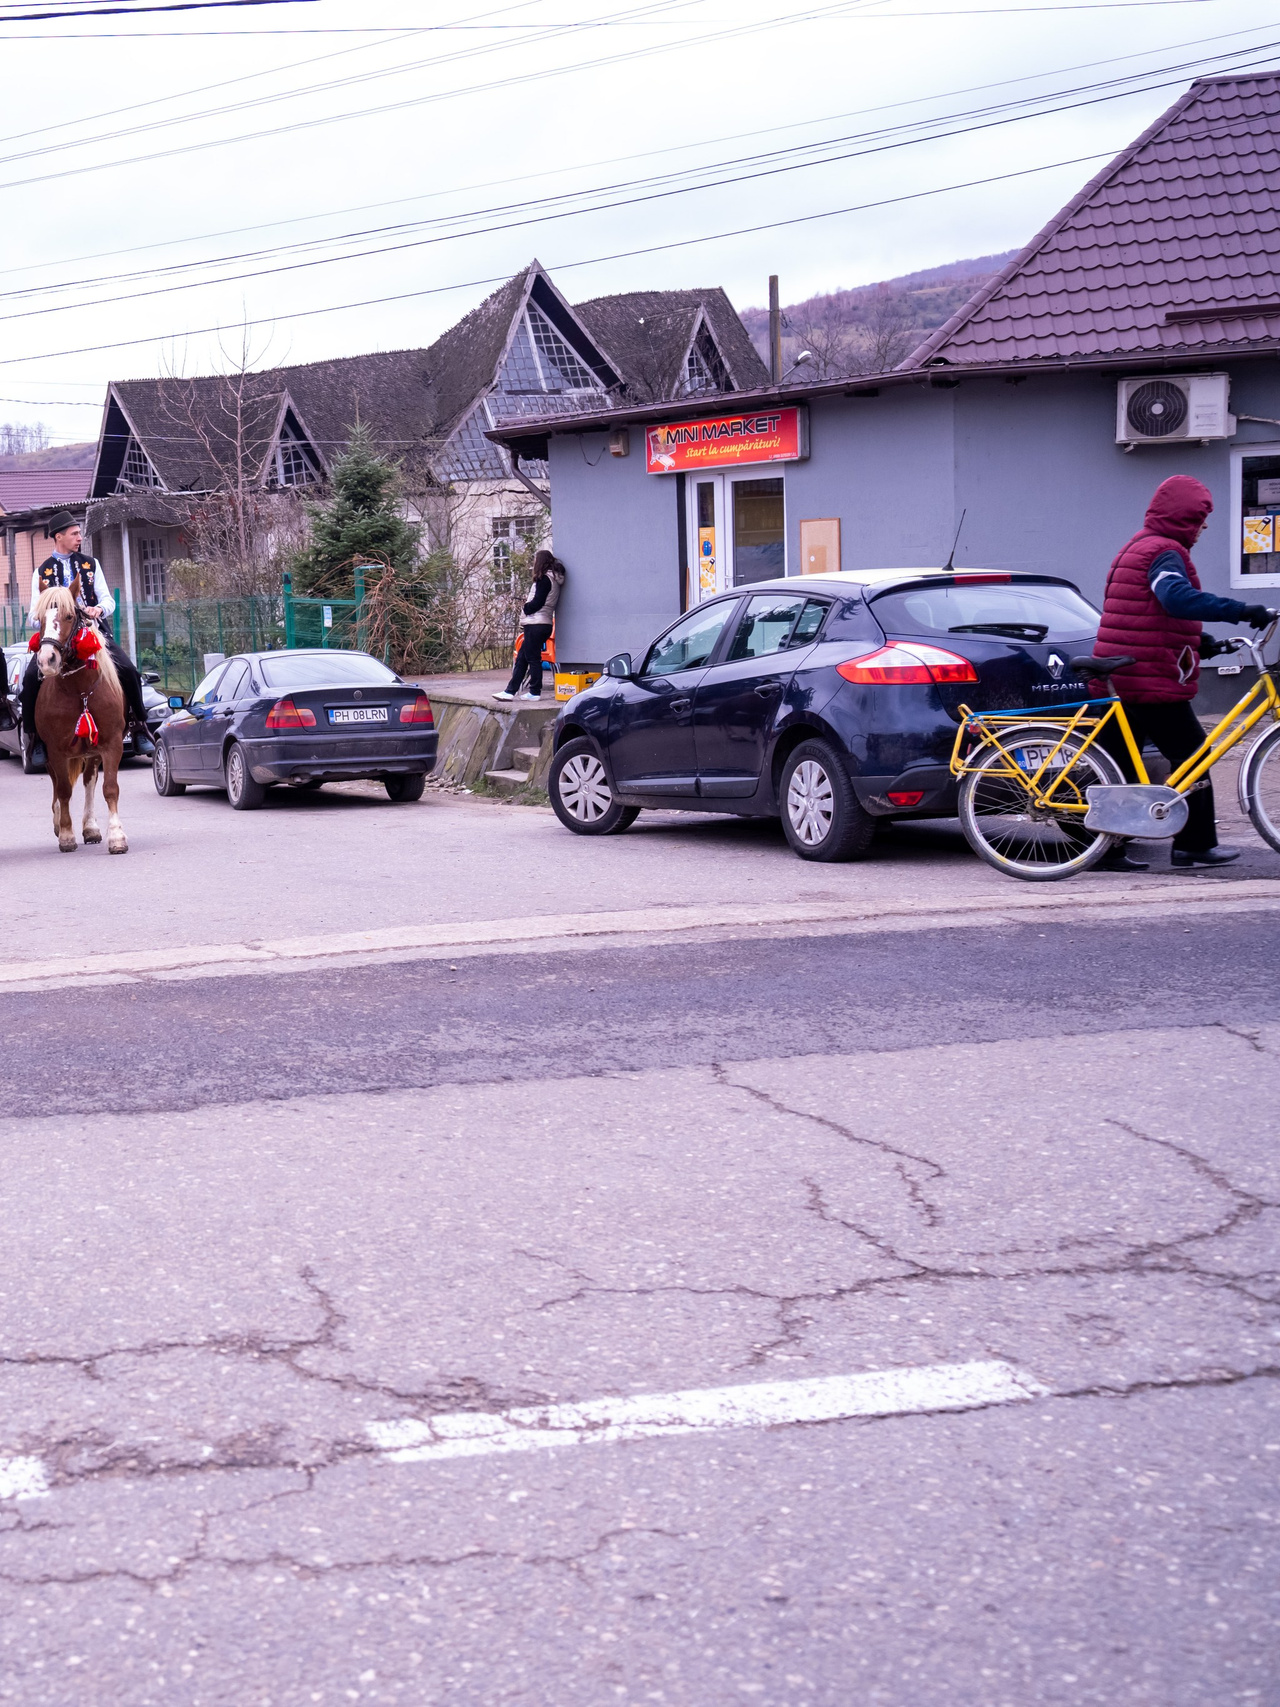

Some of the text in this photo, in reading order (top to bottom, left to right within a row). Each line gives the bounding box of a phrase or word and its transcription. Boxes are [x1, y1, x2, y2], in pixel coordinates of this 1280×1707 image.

[666, 415, 781, 444] MINI MARKET
[685, 446, 707, 458] Start
[708, 443, 719, 455] la
[334, 711, 350, 721] PH
